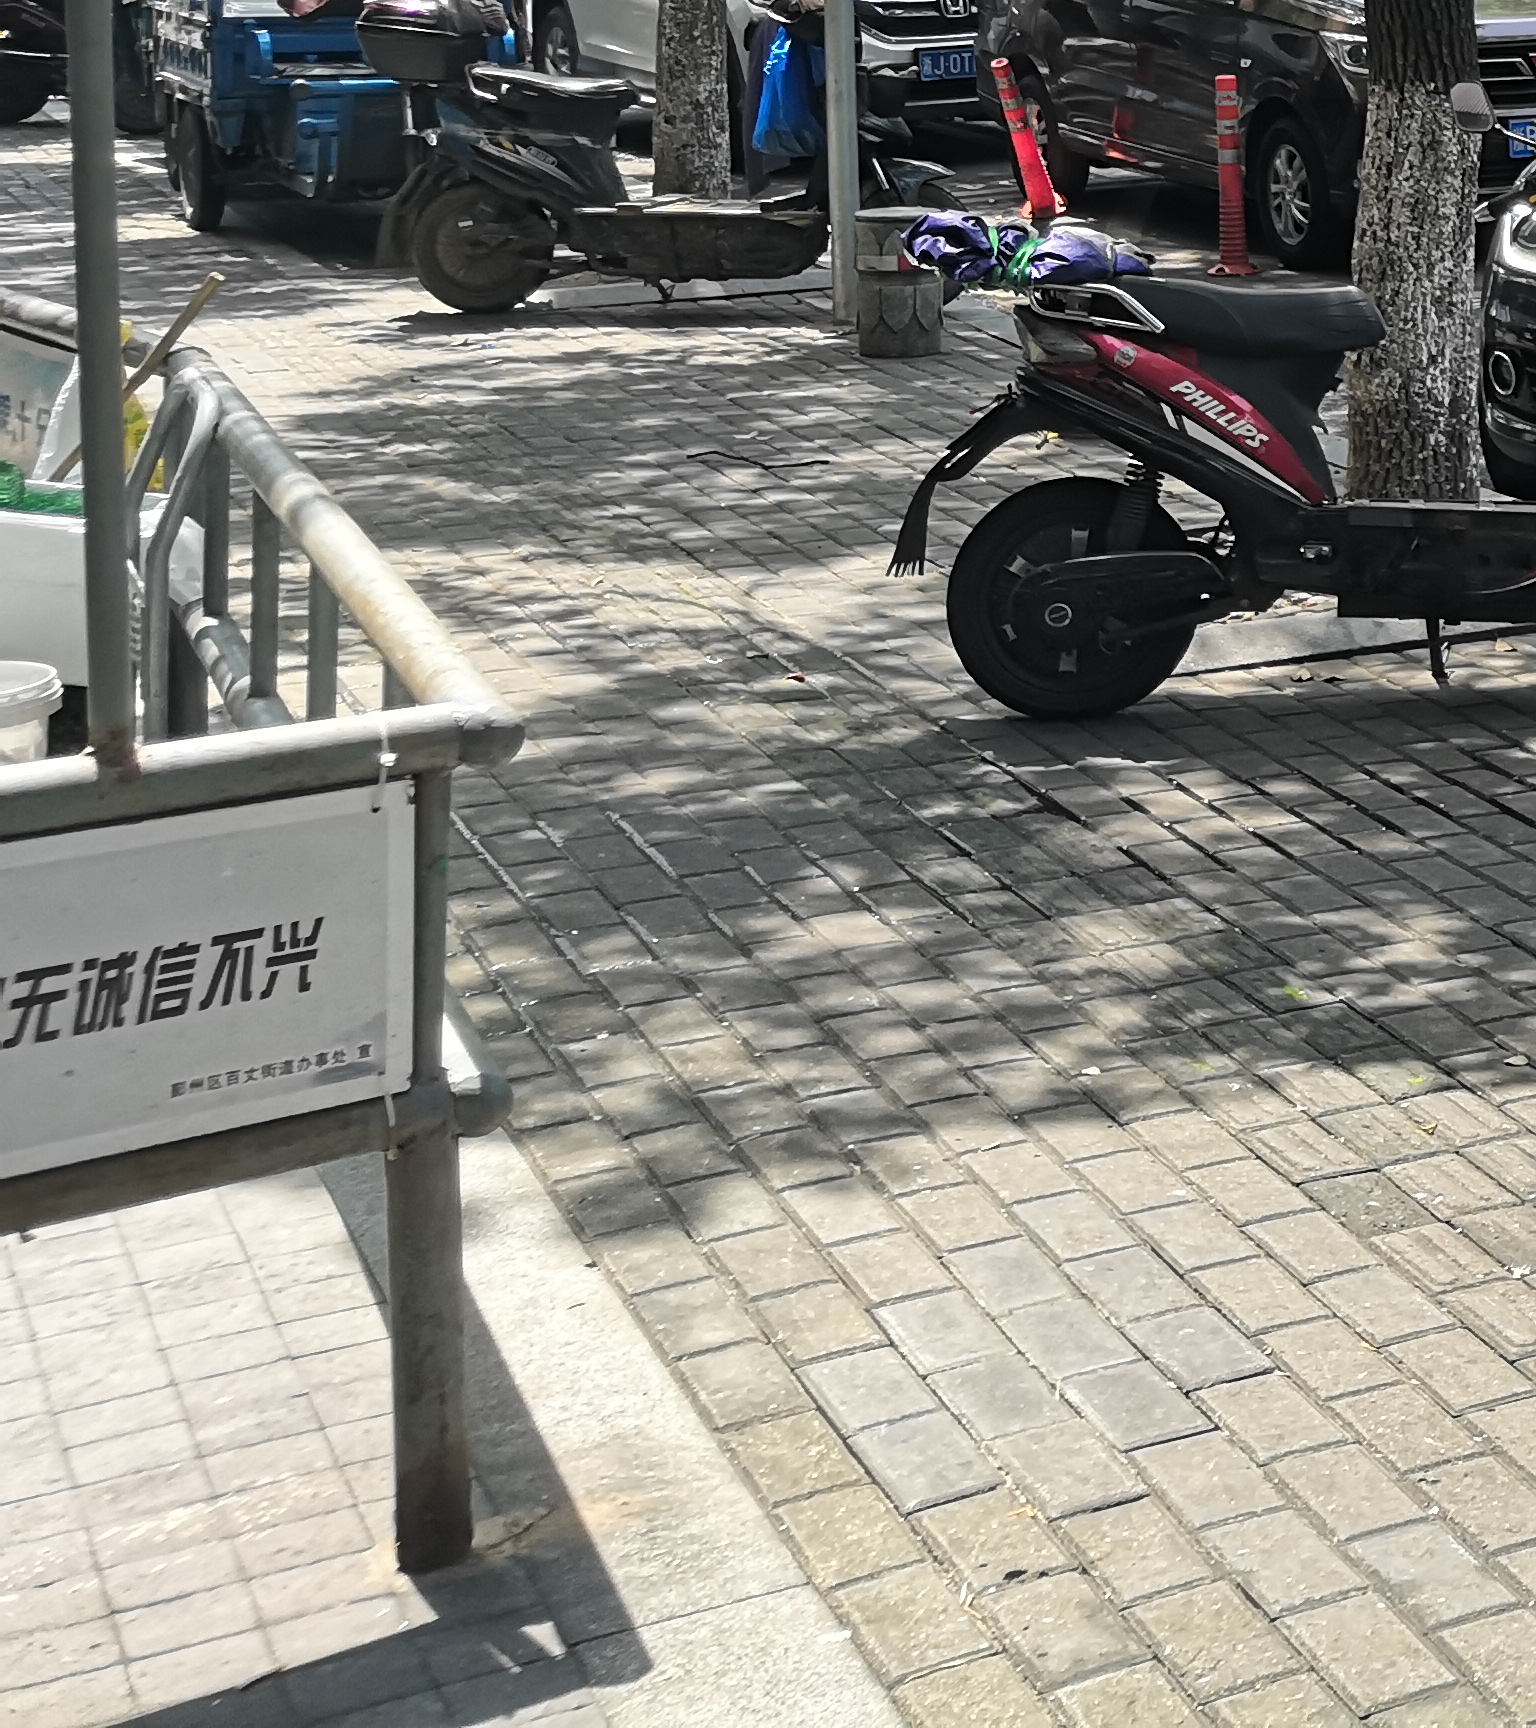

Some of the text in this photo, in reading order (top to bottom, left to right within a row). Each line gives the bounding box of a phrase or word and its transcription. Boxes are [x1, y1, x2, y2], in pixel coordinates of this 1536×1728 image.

[1169, 380, 1270, 448] PHILLIPS
[0, 916, 326, 1050] 无诚信不兴
